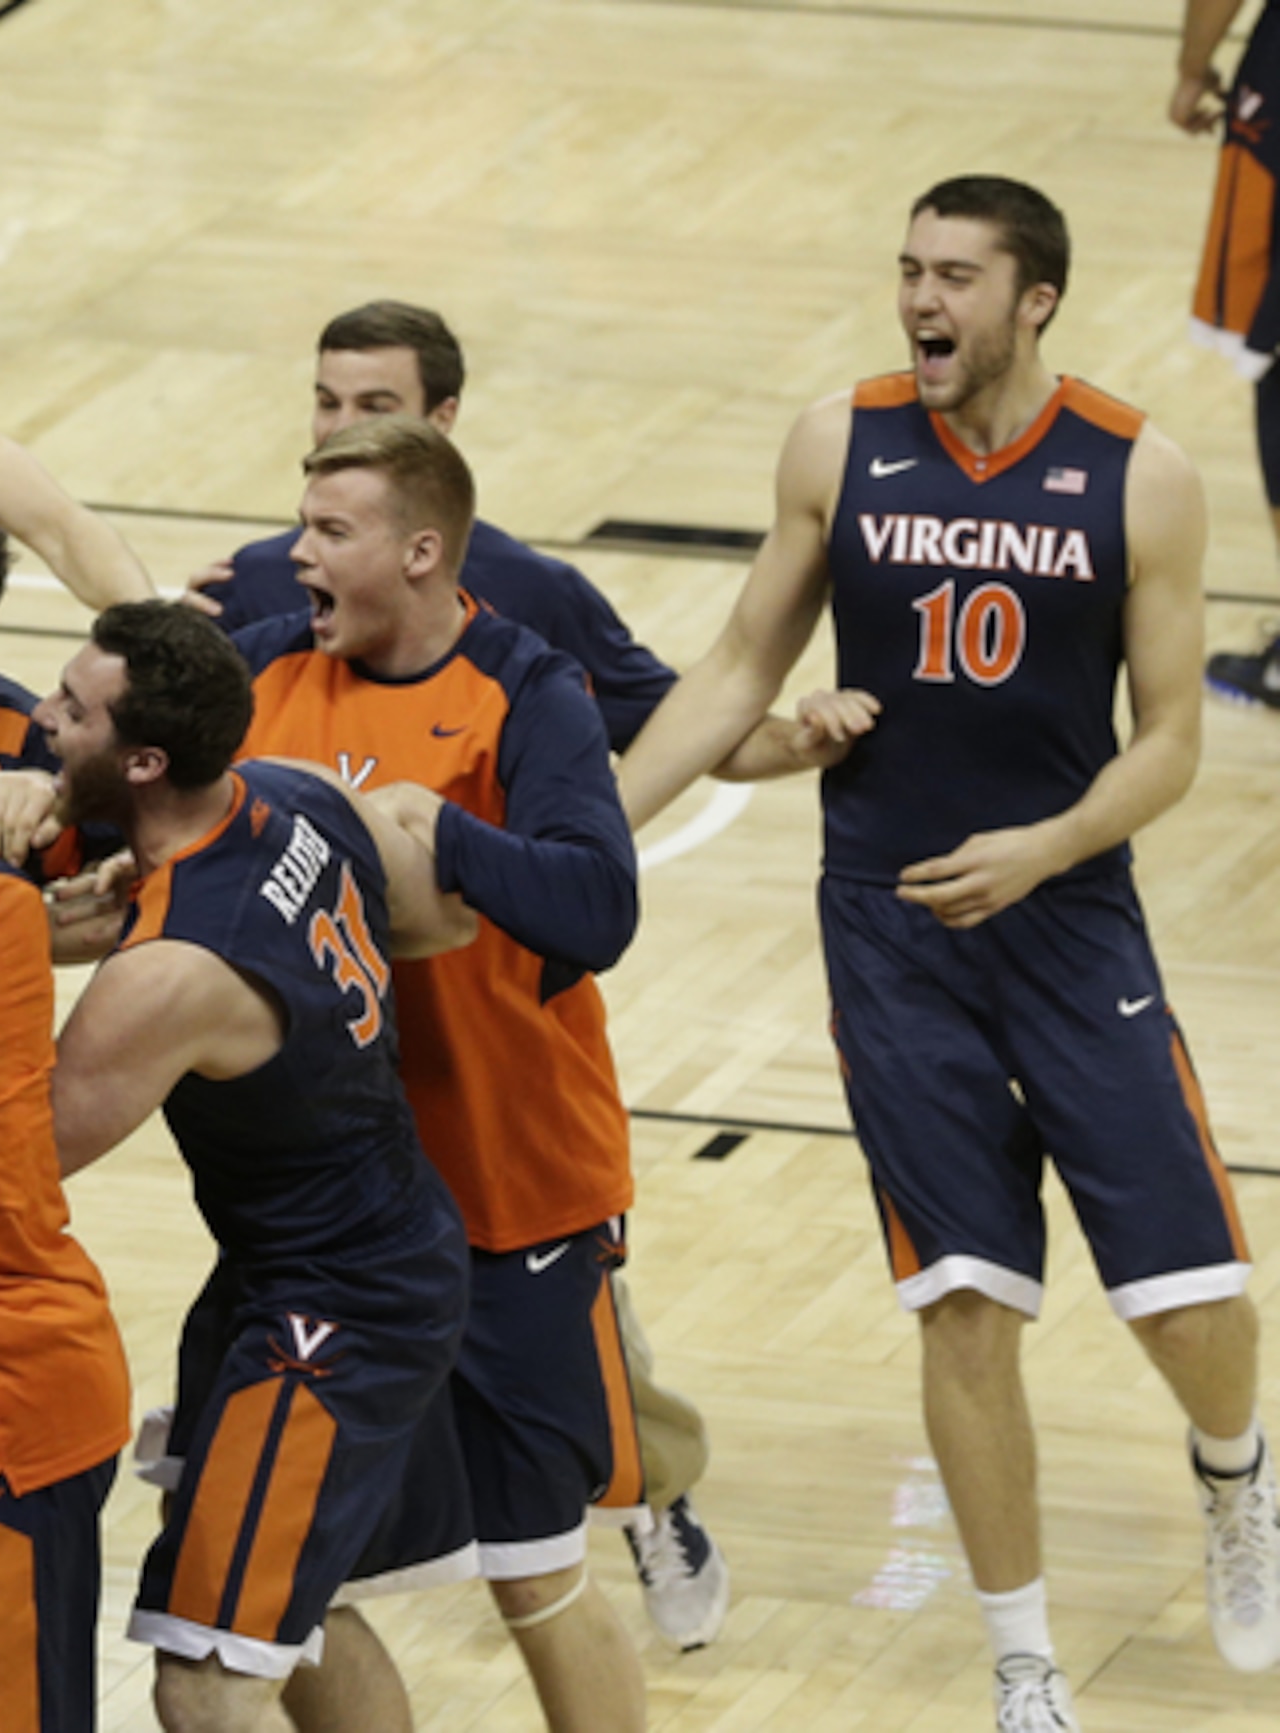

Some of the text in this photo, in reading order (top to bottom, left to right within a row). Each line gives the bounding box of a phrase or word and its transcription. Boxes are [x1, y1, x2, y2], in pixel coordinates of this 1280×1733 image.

[858, 514, 1096, 581] VIRGINIA
[912, 577, 1026, 687] 10
[308, 858, 390, 1049] 31
